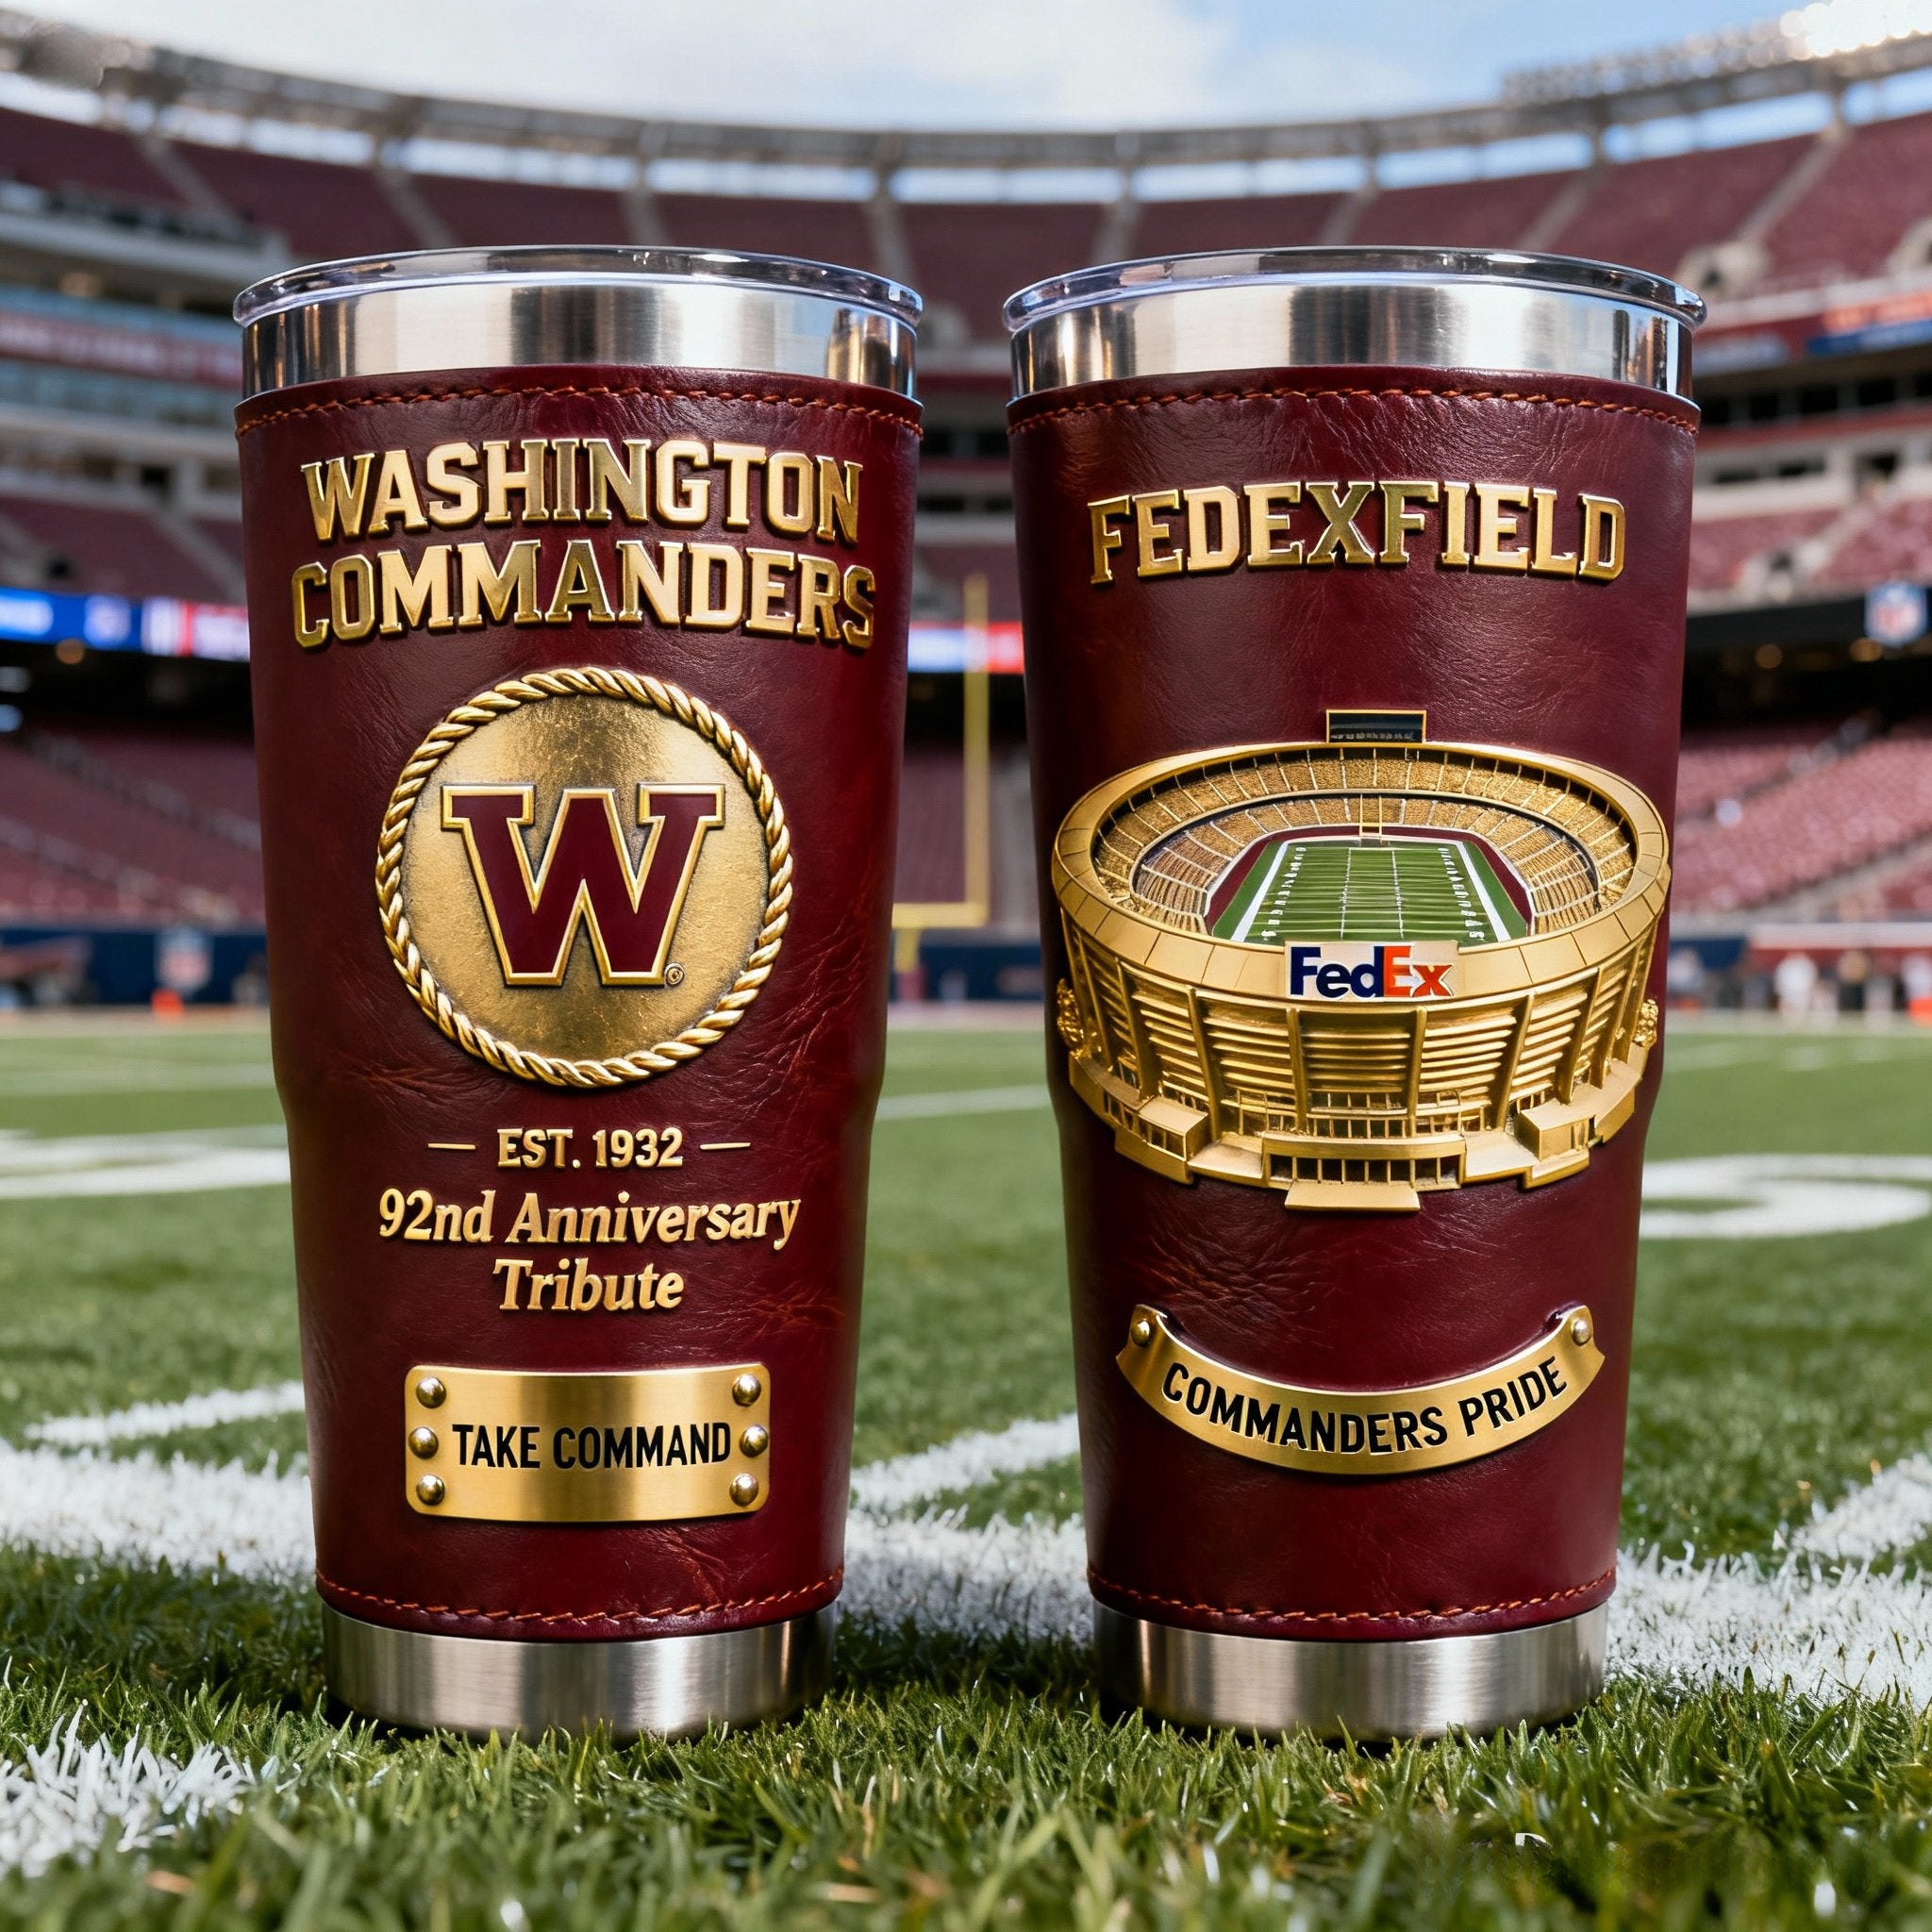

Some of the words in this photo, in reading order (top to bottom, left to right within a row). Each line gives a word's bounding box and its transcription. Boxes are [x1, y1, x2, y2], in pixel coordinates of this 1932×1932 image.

[301, 439, 864, 544] WASHINGTON
[1088, 480, 1626, 587] FEDEXFIELD
[291, 539, 876, 649] COMMANDERS
[441, 783, 725, 988] W
[1290, 945, 1455, 999] FedEx
[497, 1127, 581, 1169] EST.
[592, 1126, 684, 1169] 1932
[378, 1188, 496, 1242] 92nd
[505, 1191, 802, 1250] Anniversary
[491, 1257, 685, 1311] Tribute
[452, 1423, 541, 1470] TAKE
[552, 1421, 732, 1471] COMMAND
[1160, 1361, 1449, 1456] COMMANDERS
[1457, 1355, 1568, 1437] PRIDE
